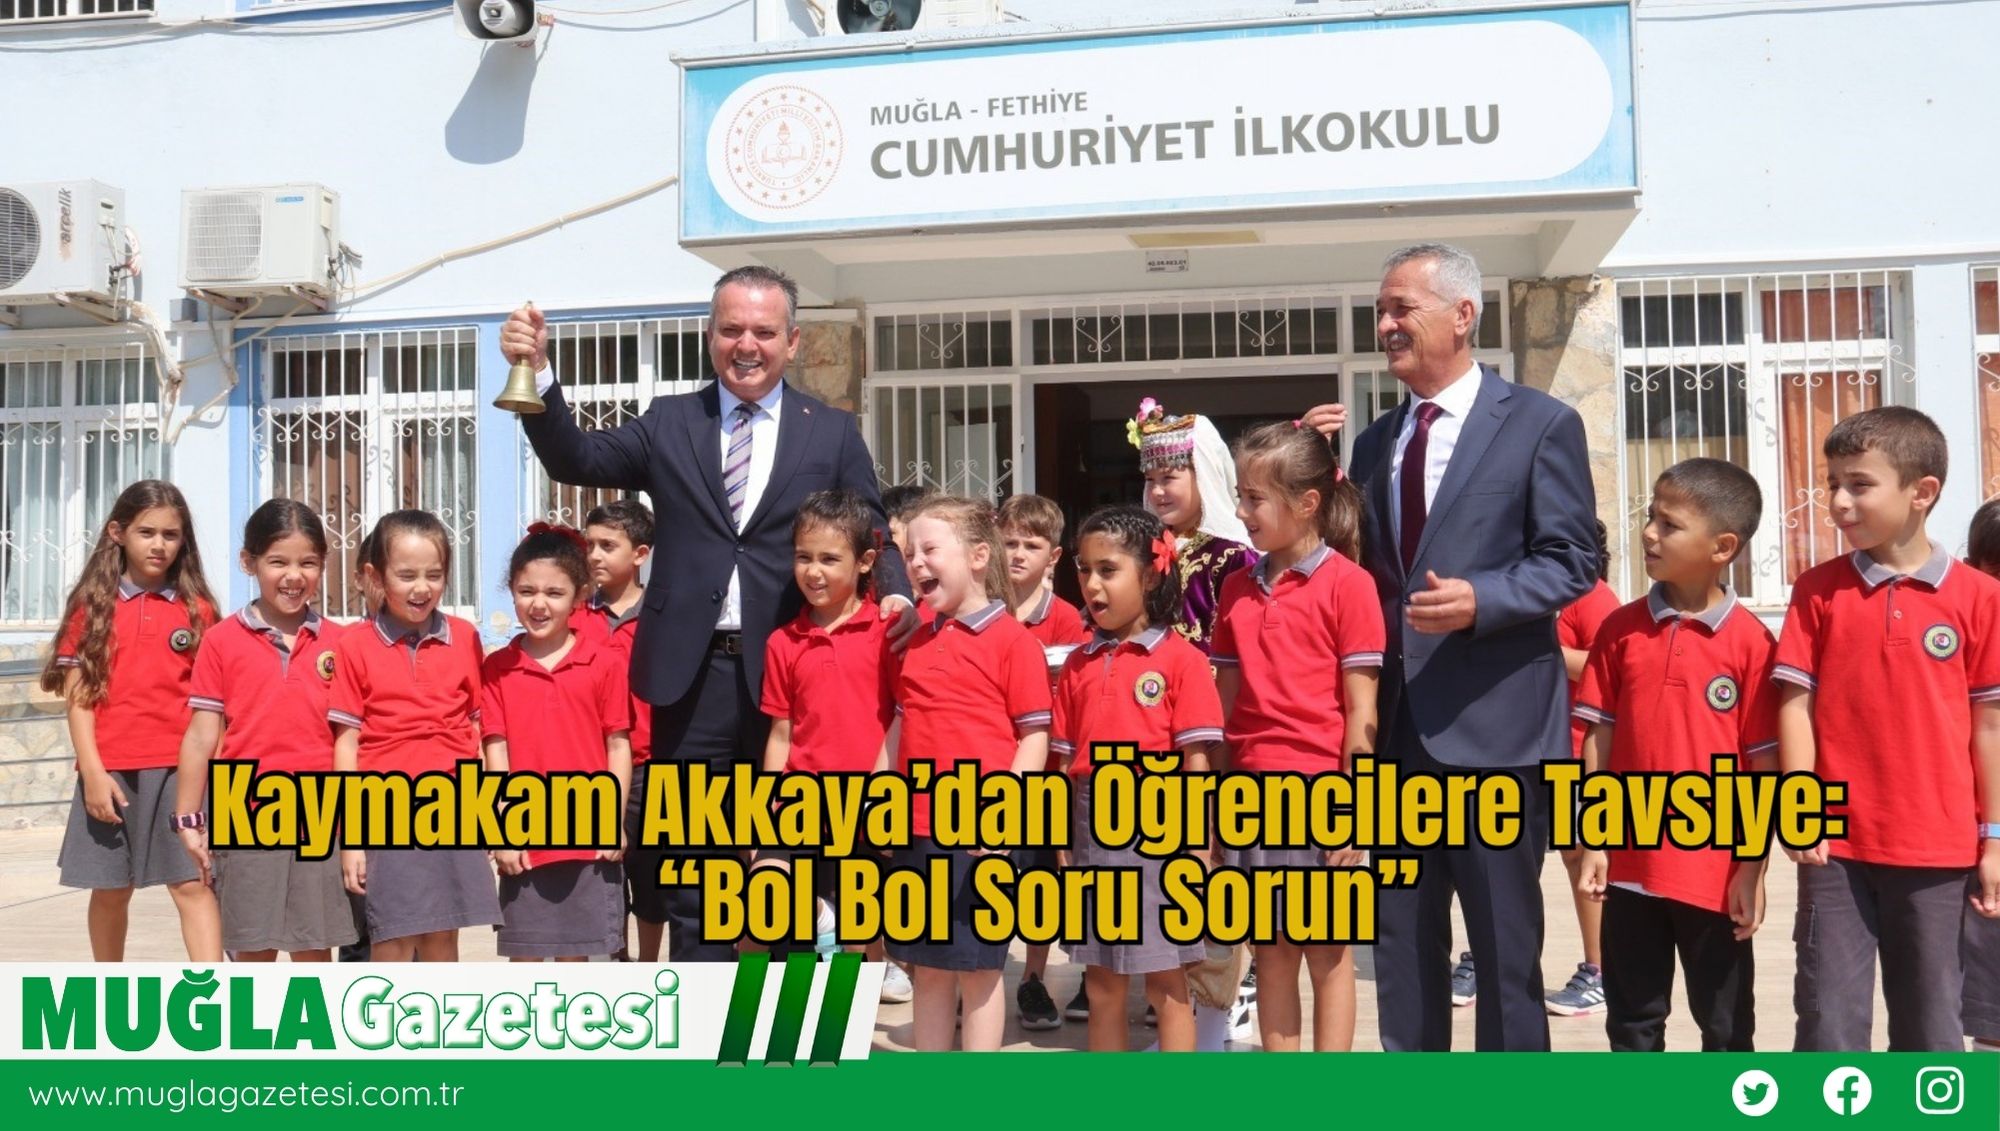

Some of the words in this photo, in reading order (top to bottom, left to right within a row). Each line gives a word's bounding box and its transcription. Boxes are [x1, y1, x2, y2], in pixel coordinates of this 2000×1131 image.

[870, 98, 962, 126] MUĞLA
[987, 88, 1088, 118] FETHİYE
[870, 114, 1215, 180] CUMHURİYET
[1234, 104, 1499, 157] İLKOKULU
